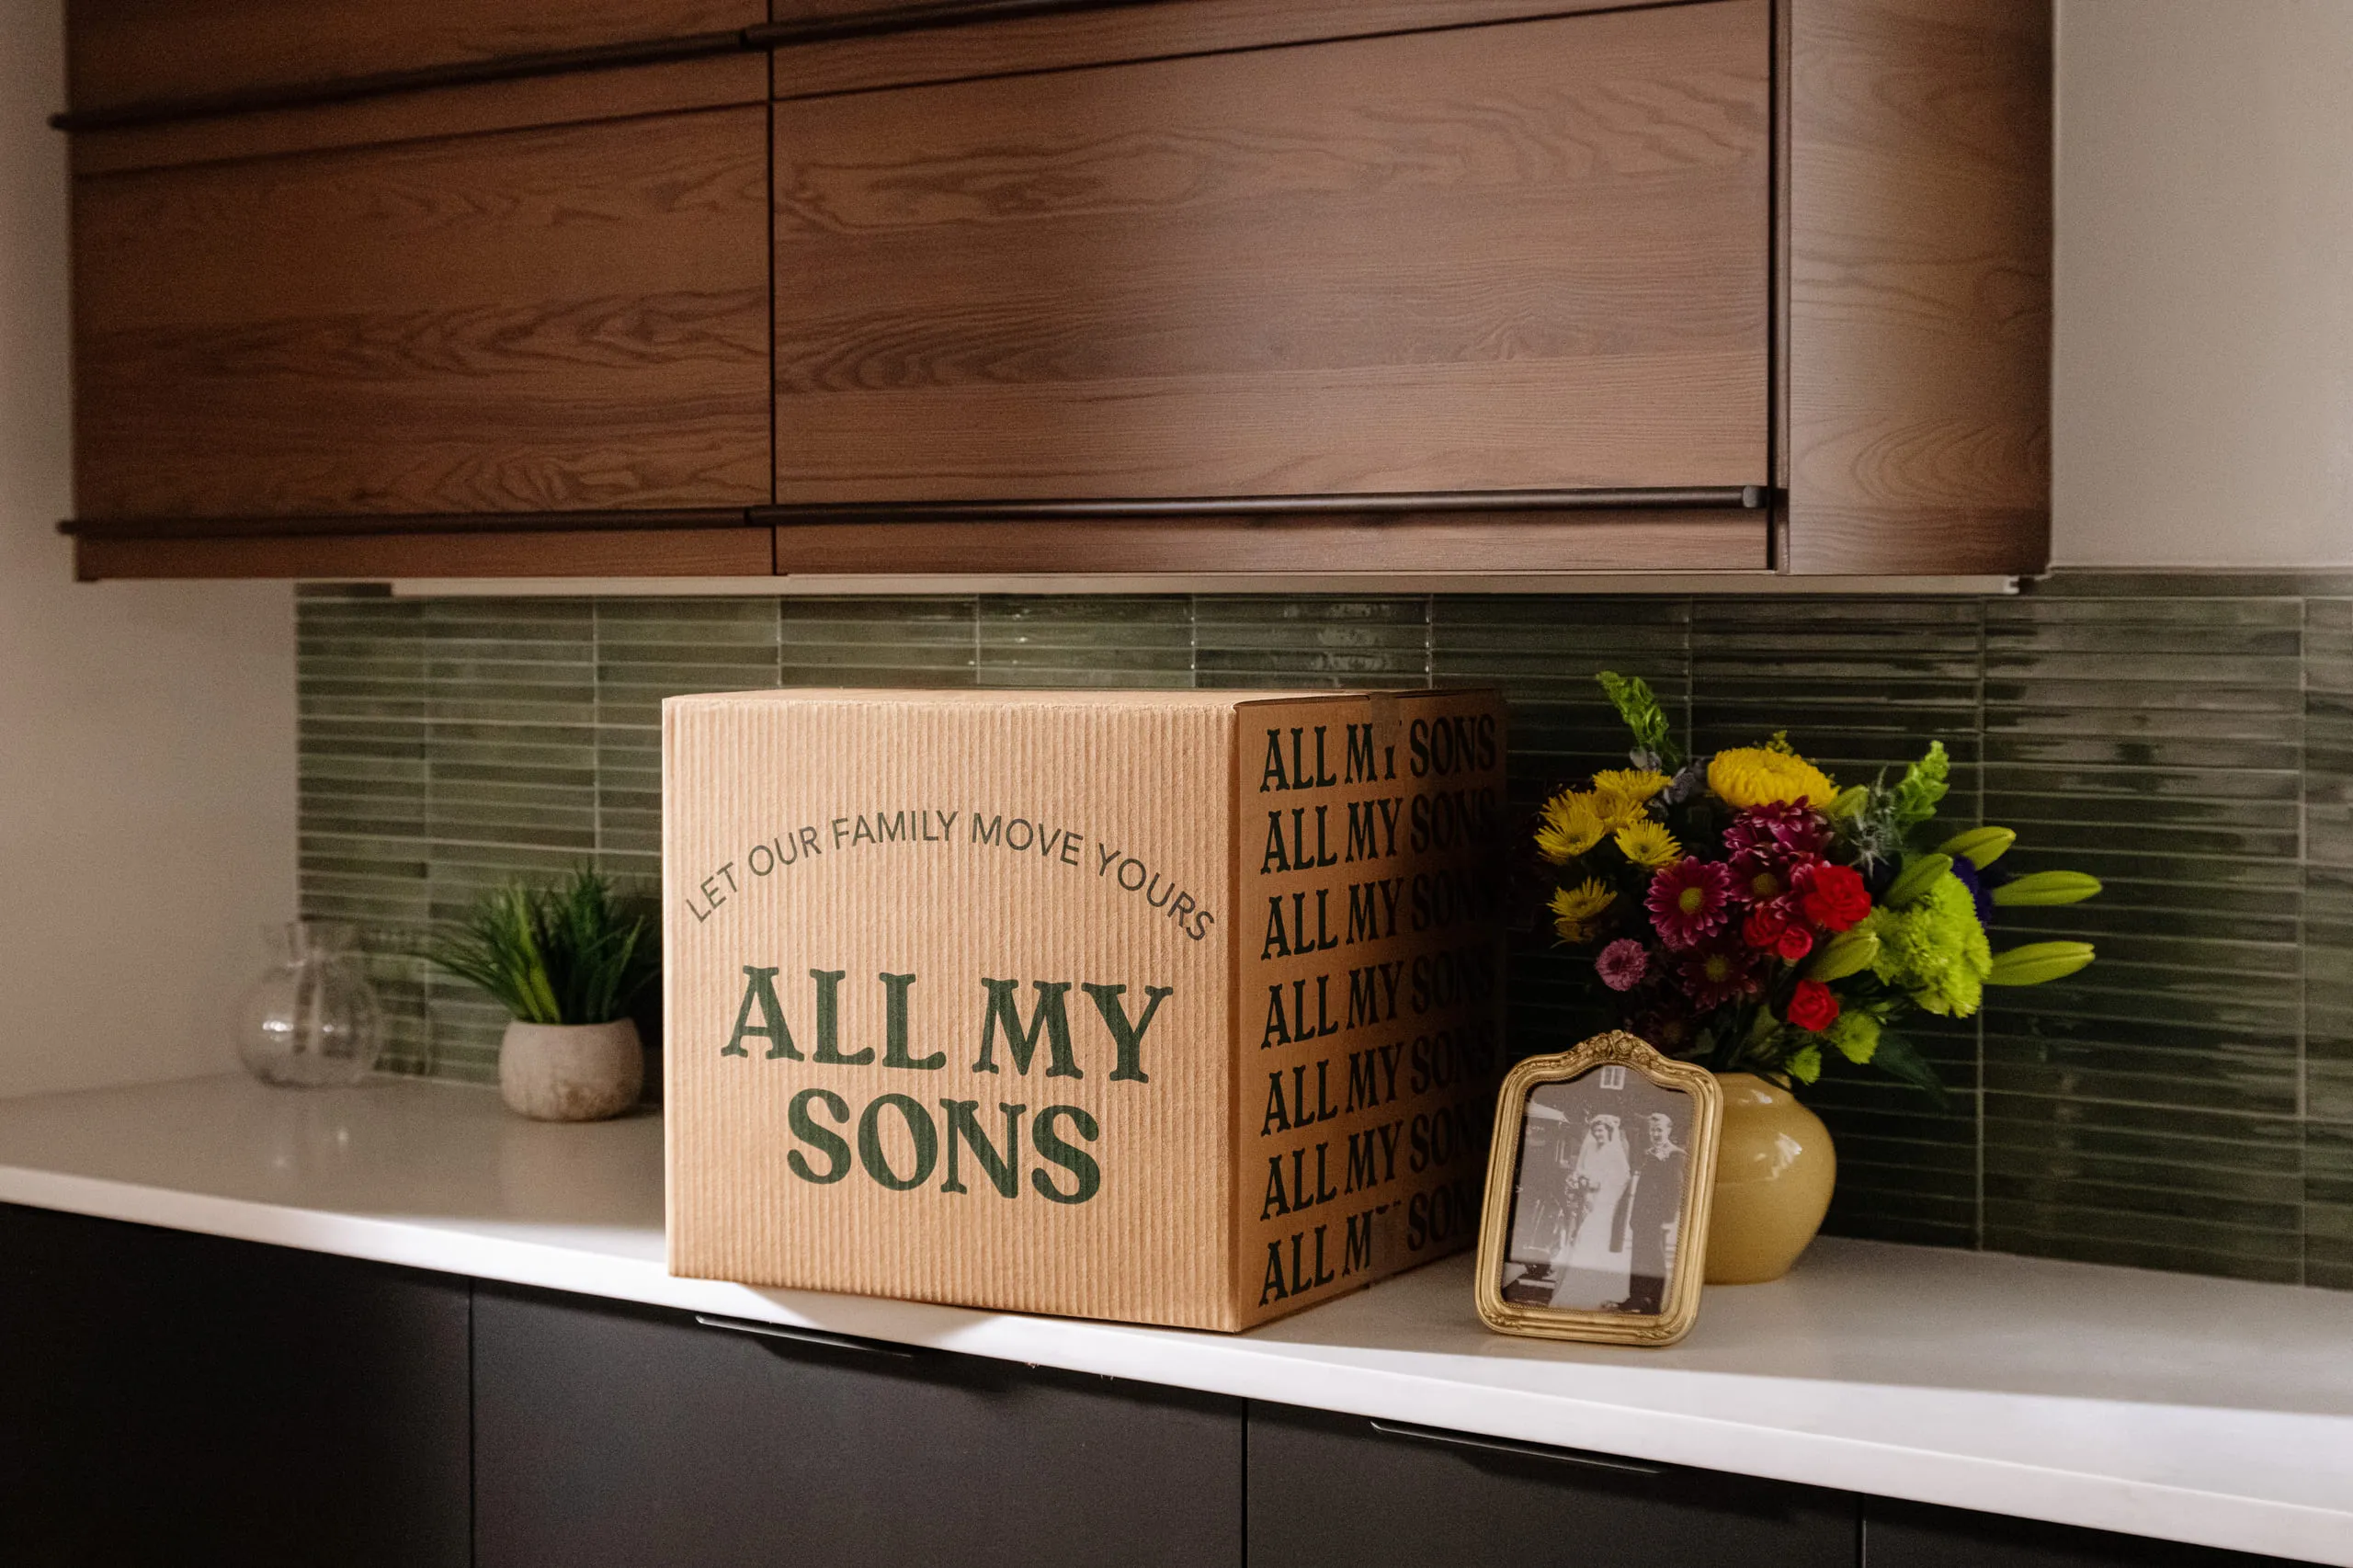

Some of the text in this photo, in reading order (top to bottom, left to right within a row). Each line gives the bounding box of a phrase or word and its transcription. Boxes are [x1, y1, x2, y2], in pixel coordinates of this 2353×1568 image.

[1259, 725, 1336, 793] ALL
[1409, 713, 1495, 778] SONS
[686, 810, 1215, 941] LET OUR FAMILY MOVE YOURS
[1260, 804, 1338, 875] ALL
[1345, 797, 1404, 863] MY
[1260, 888, 1338, 960] ALL
[1346, 877, 1404, 945] MY
[721, 966, 1174, 1085] ALL MY
[1260, 974, 1338, 1050] ALL
[1346, 960, 1404, 1030] MY
[1260, 1059, 1338, 1137] ALL
[1346, 1041, 1404, 1113] MY
[786, 1088, 1101, 1205] SONS
[1259, 1142, 1337, 1221] ALL
[1344, 1119, 1404, 1195] MY
[1258, 1177, 1482, 1308] ALL M SON
